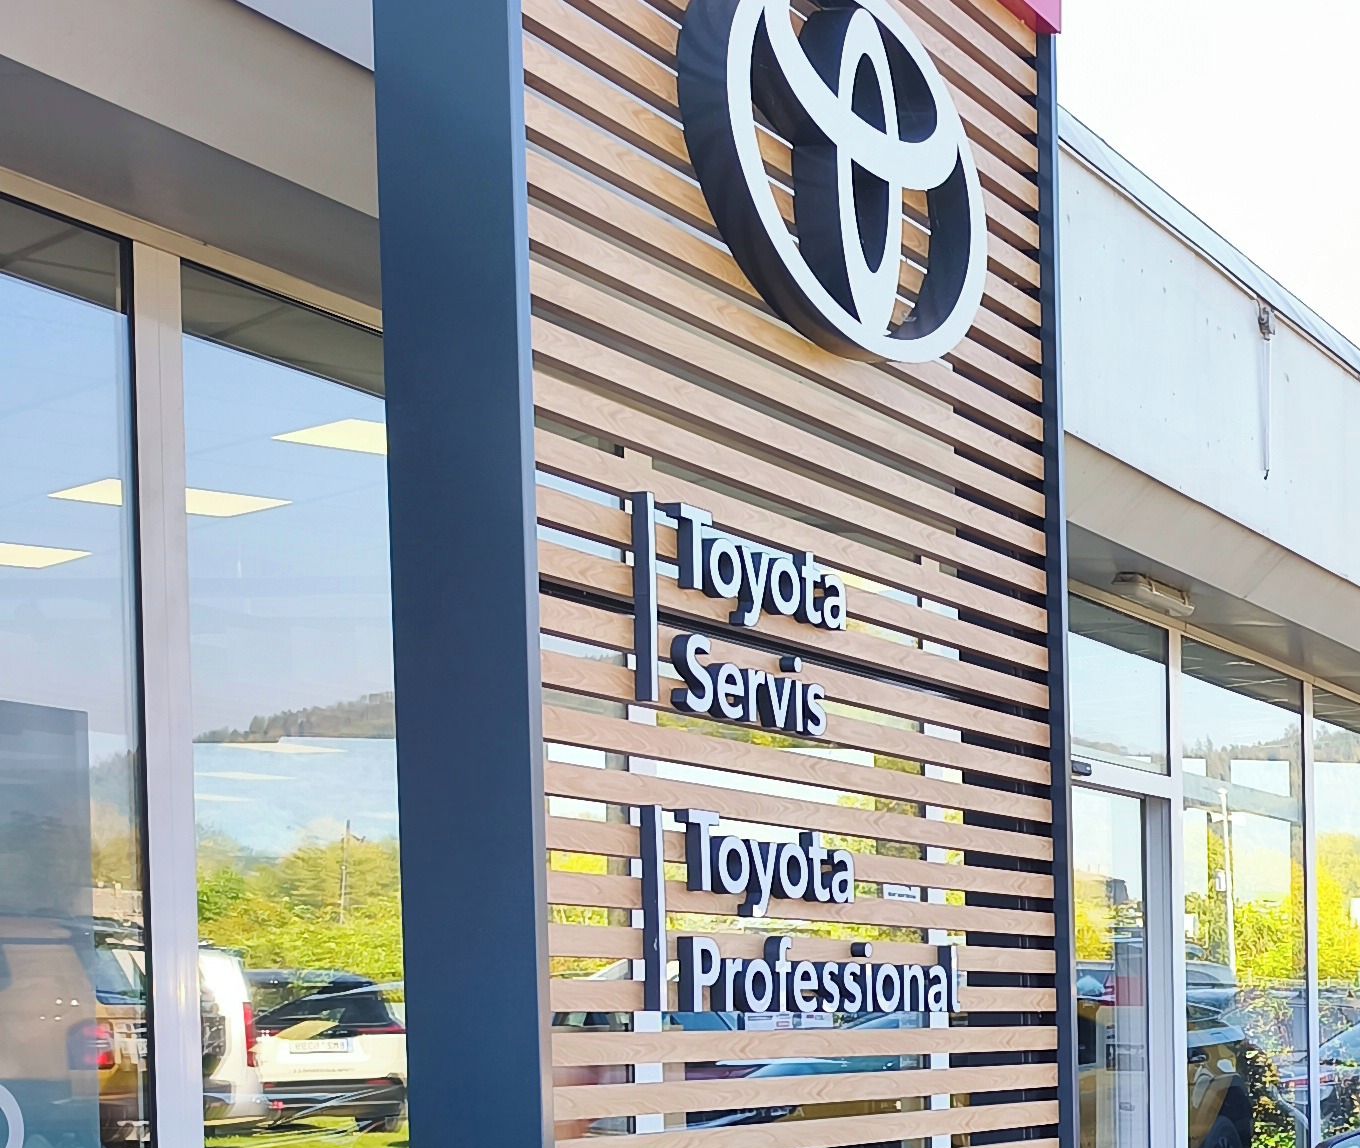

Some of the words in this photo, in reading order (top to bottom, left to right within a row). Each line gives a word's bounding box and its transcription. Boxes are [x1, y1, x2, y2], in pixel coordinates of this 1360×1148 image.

[681, 503, 847, 630] Toyota
[685, 633, 828, 736] Servis
[693, 810, 857, 918] Toyota
[693, 936, 961, 1014] Professional
